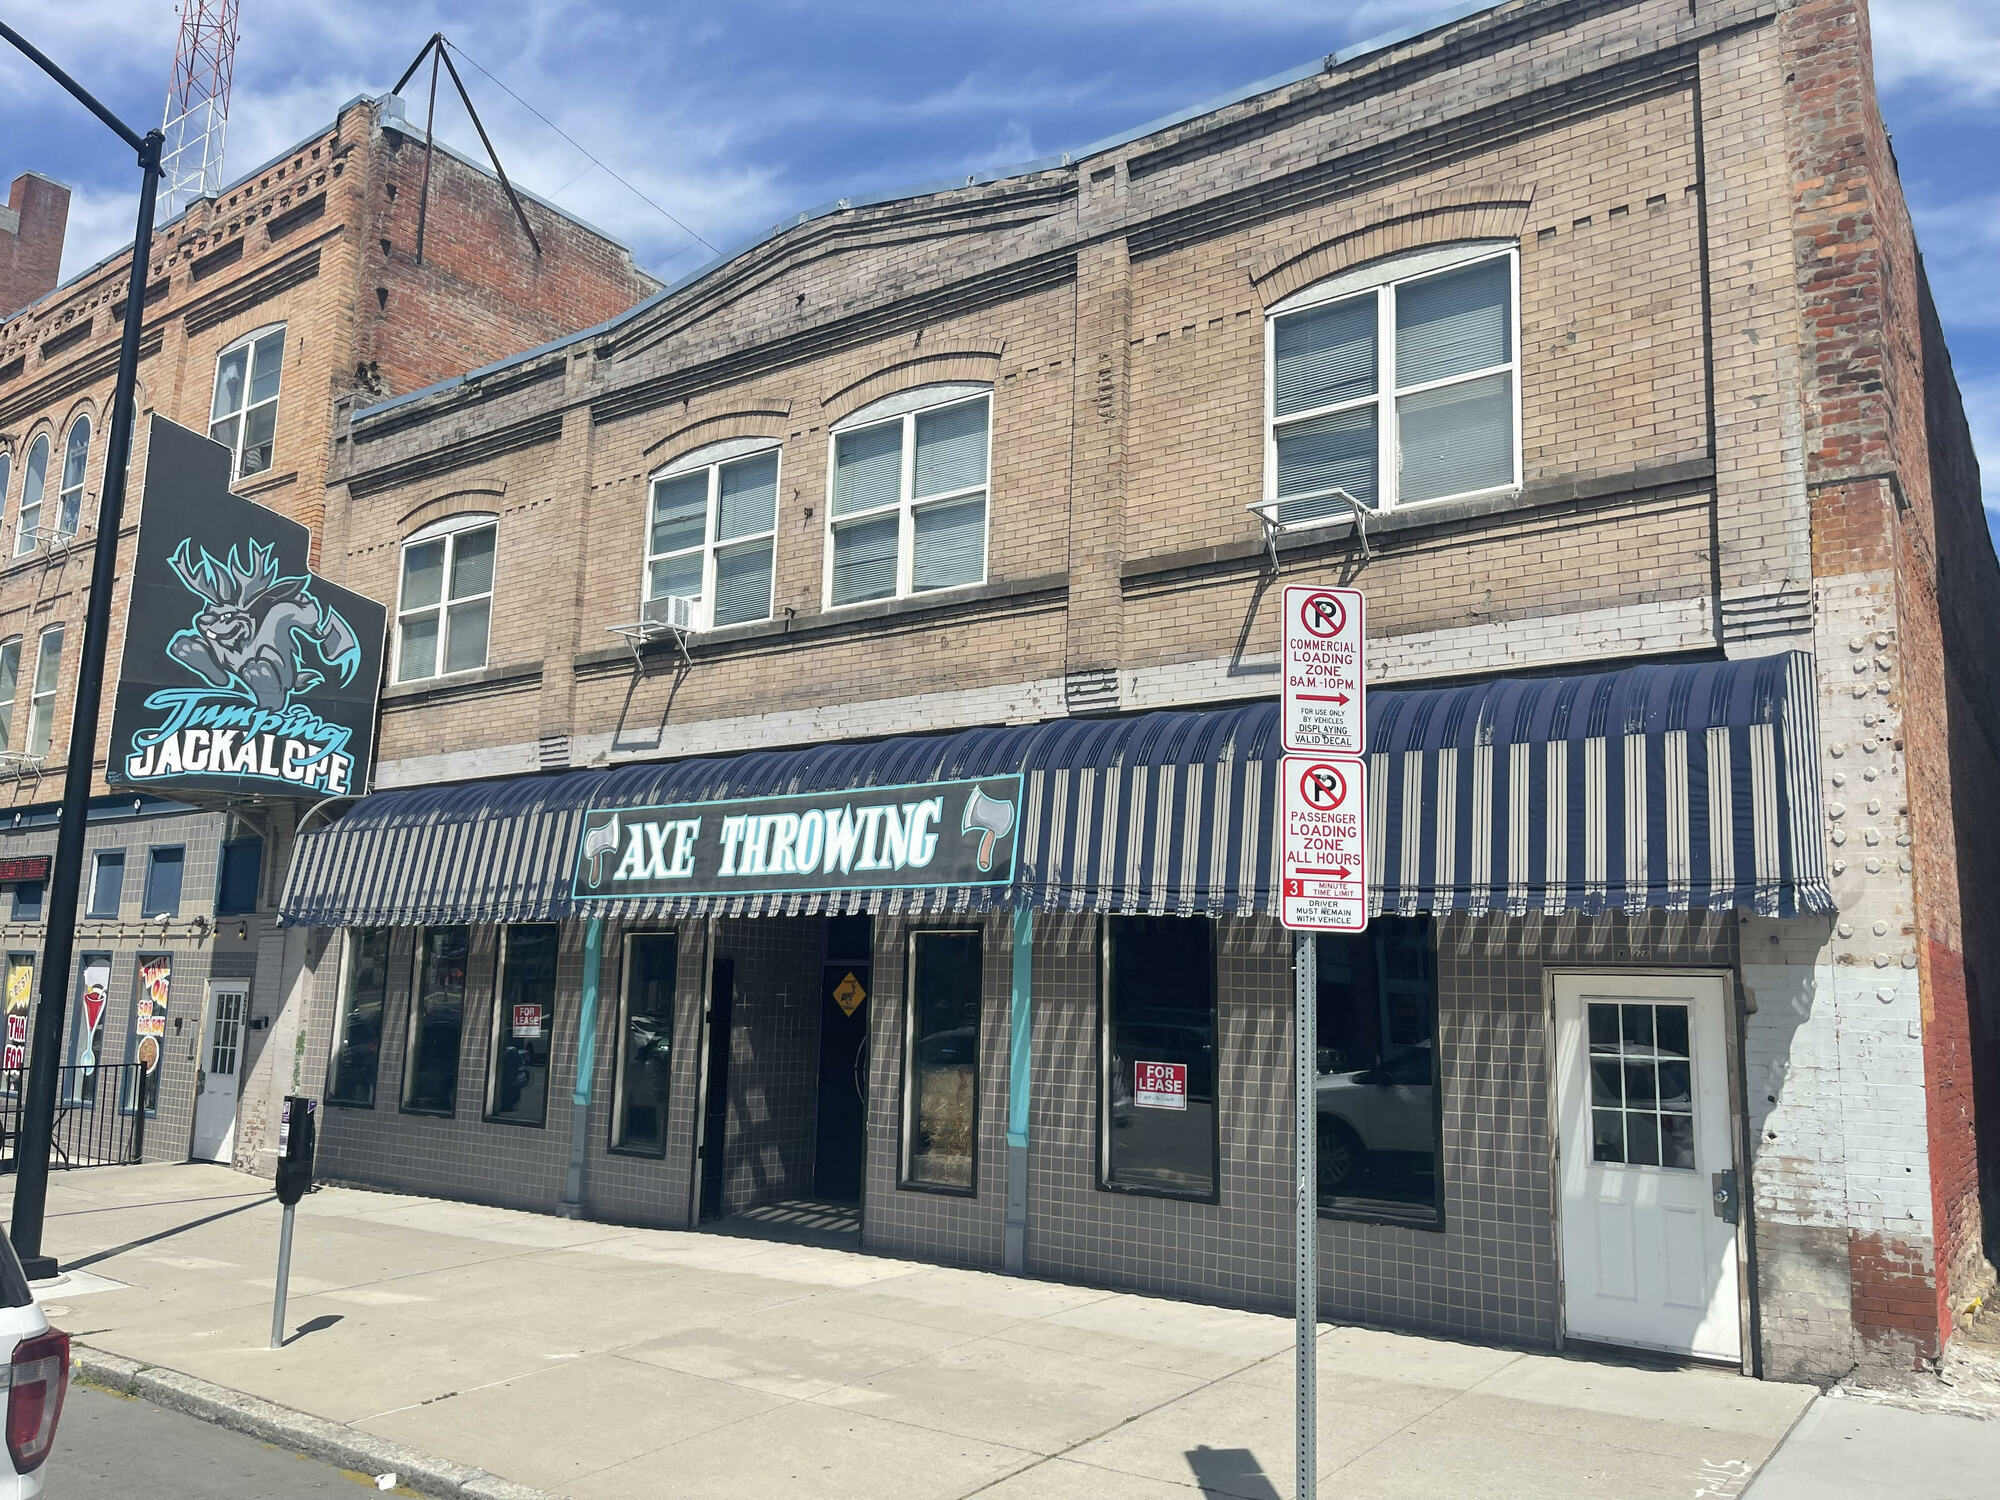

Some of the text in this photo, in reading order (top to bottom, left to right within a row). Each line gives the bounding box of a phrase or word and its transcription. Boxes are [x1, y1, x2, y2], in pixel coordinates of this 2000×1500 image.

[1290, 638, 1356, 653] COMMERCIAL
[1293, 651, 1353, 665] LOADING
[1305, 664, 1342, 677] ZONE
[1301, 707, 1345, 717] FOR USE ONLY
[135, 688, 352, 765] Jumping
[1314, 717, 1344, 725] VEHICLES
[1299, 724, 1348, 735] DISPLAYING
[1295, 734, 1352, 746] VALID DECAL
[129, 728, 349, 793] JACKALOPE
[1291, 811, 1356, 824] PASSENGER
[1290, 823, 1357, 838] LOADING
[613, 796, 944, 880] AXE THROWING
[1303, 837, 1344, 851] ZONE
[1287, 851, 1361, 866] ALL HOURS
[1289, 880, 1348, 895] 3 MINUTE
[1333, 889, 1355, 897] LIMIT
[1296, 907, 1318, 915] MUST
[1309, 900, 1338, 908] DRIVER
[1296, 915, 1352, 924] WITH VEHICLE
[519, 1007, 535, 1016] FOR
[515, 1016, 539, 1025] LEASE
[9, 1016, 26, 1041] THA
[4, 1046, 23, 1070] FOO
[1146, 1065, 1174, 1079] FOR
[1138, 1077, 1183, 1093] LEASE
